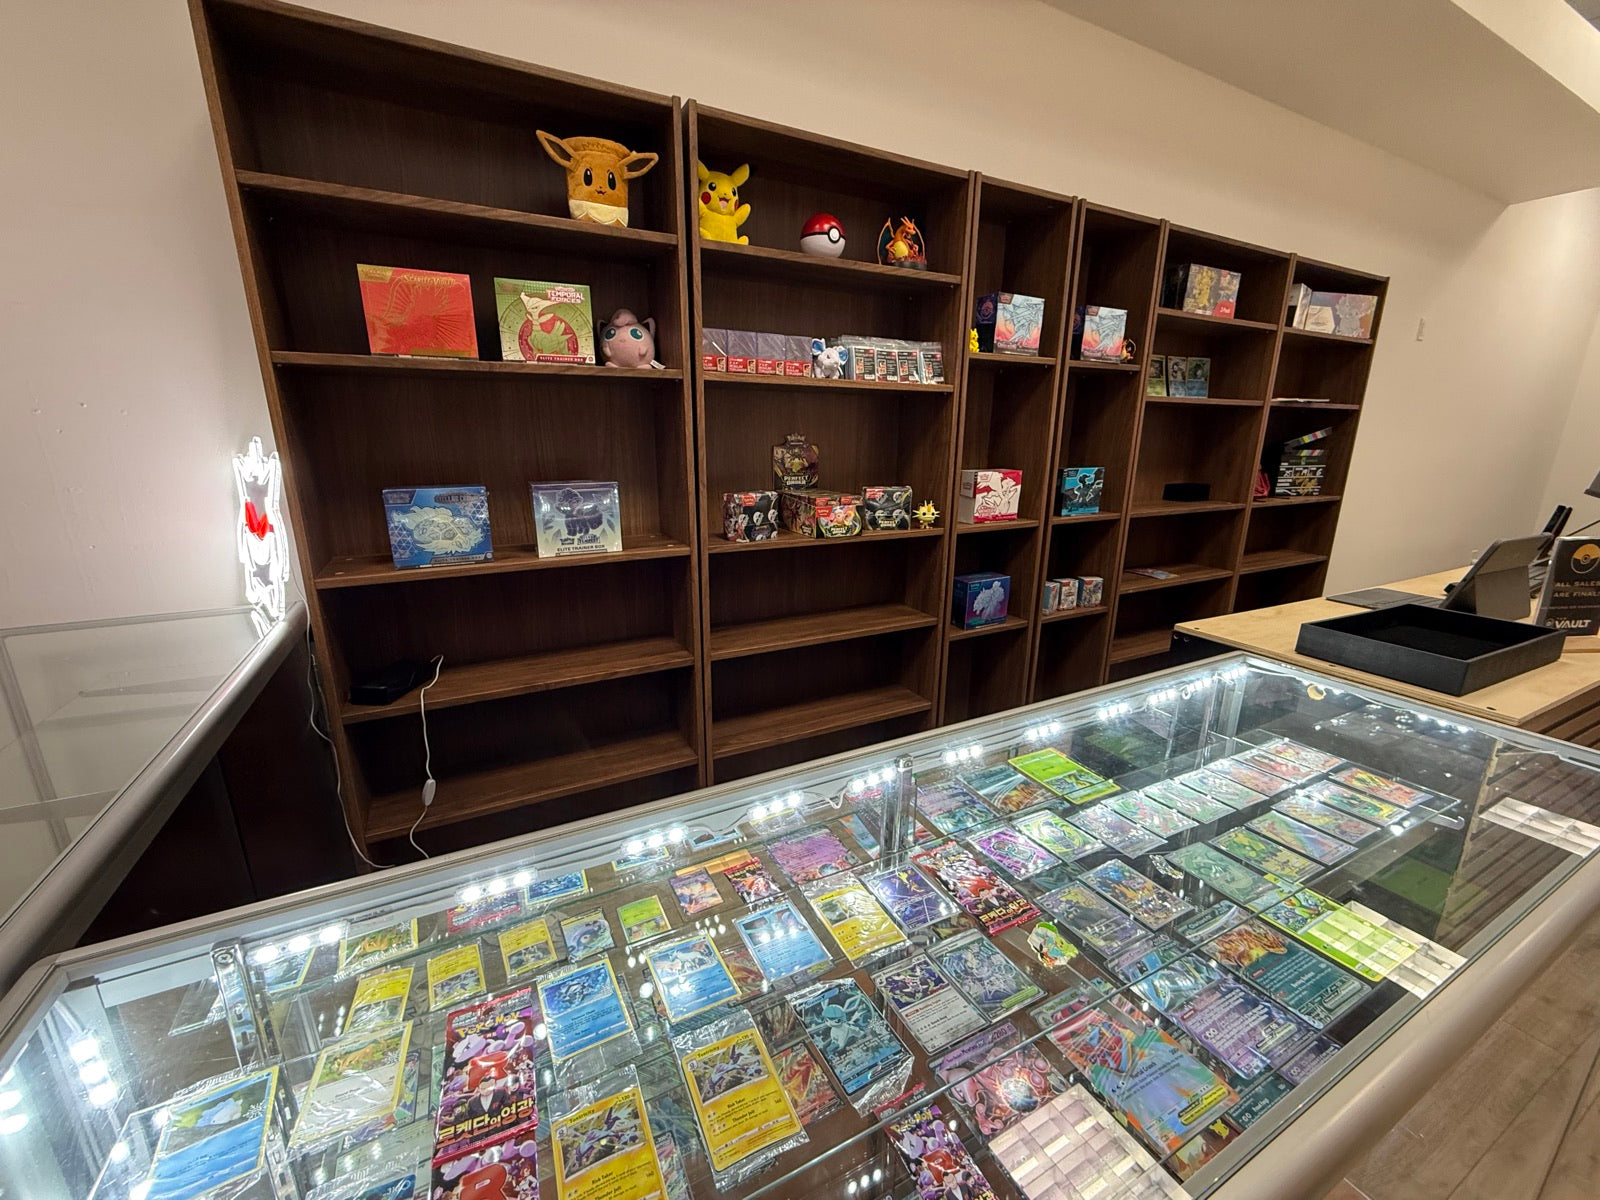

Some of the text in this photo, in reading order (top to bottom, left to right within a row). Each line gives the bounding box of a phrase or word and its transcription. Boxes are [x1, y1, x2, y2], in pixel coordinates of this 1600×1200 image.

[546, 290, 585, 300] TEMPORAL
[1555, 619, 1592, 628] VAULT
[436, 1113, 502, 1149] 로켓단의
